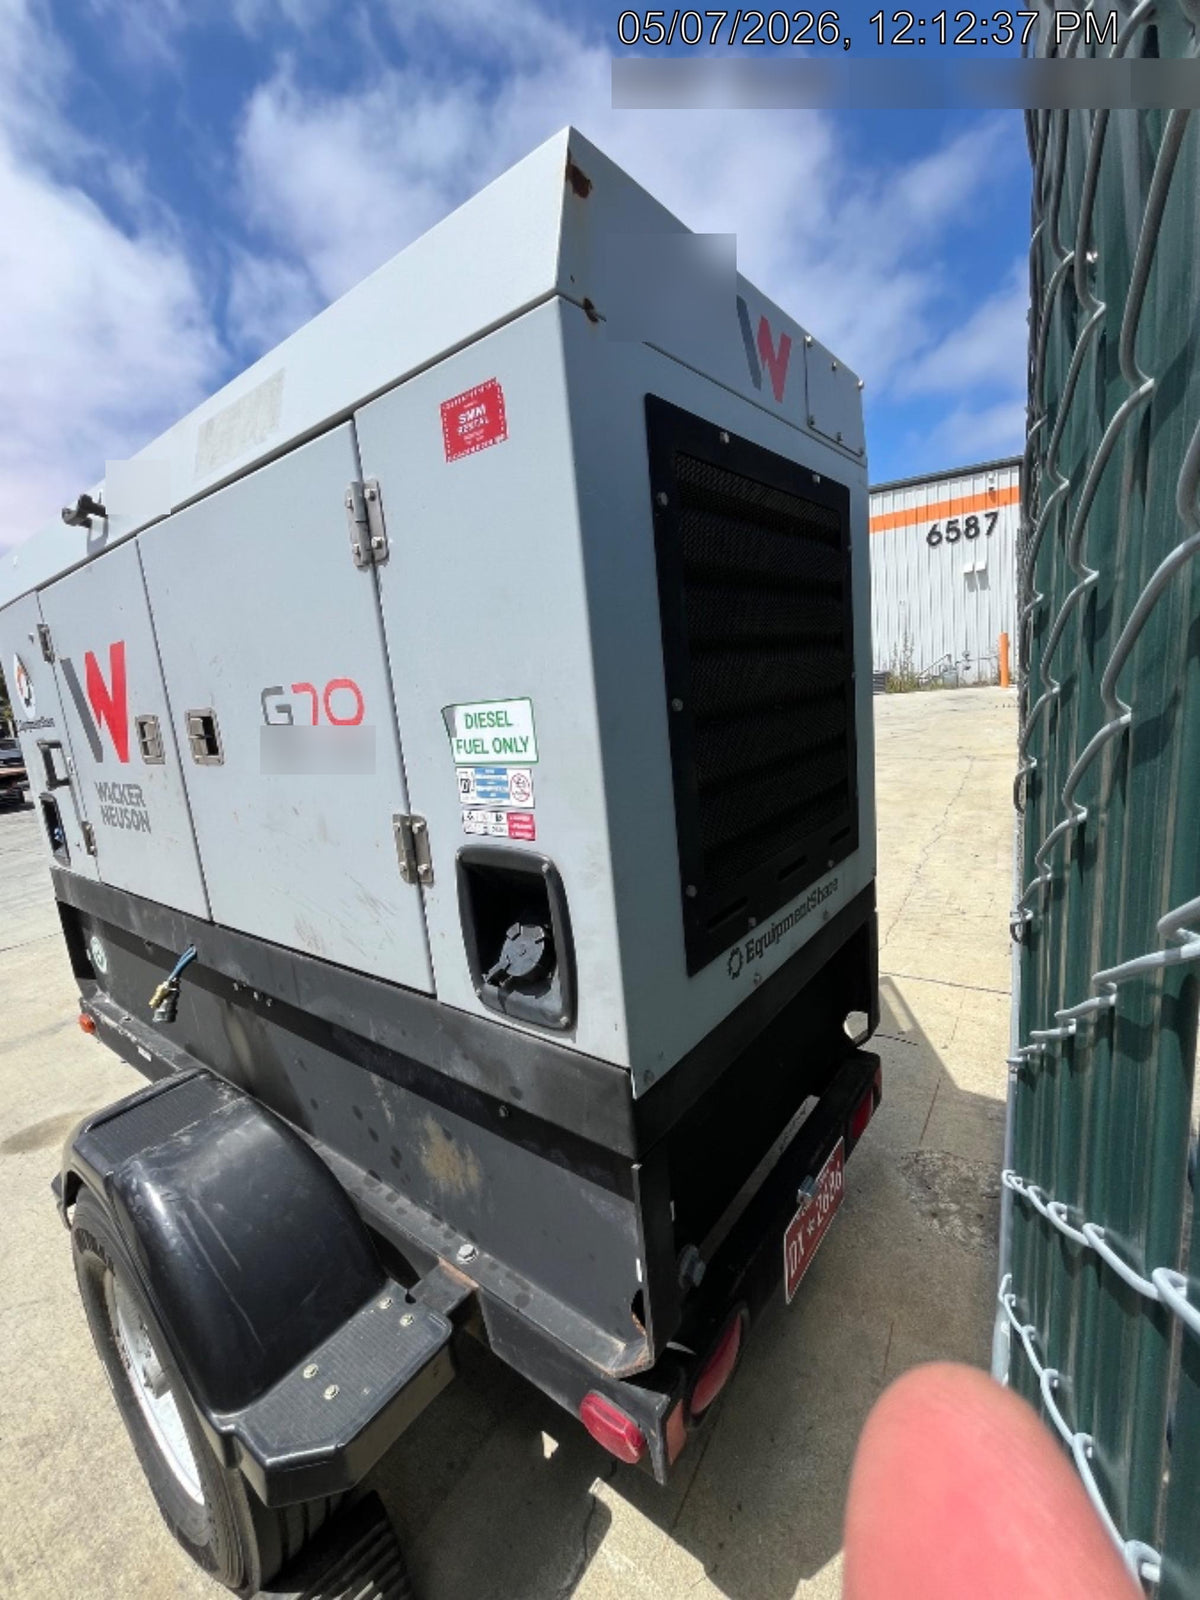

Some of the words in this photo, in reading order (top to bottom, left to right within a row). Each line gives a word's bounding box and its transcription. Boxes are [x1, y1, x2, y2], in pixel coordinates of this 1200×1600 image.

[926, 511, 999, 547] 6587
[260, 678, 366, 726] G70
[464, 710, 514, 730] DIESEL
[455, 738, 490, 755] FUEL
[492, 735, 530, 754] ONLY
[94, 781, 147, 808] WACKER
[100, 804, 152, 834] NEUSON
[745, 877, 839, 964] EquipmentShare
